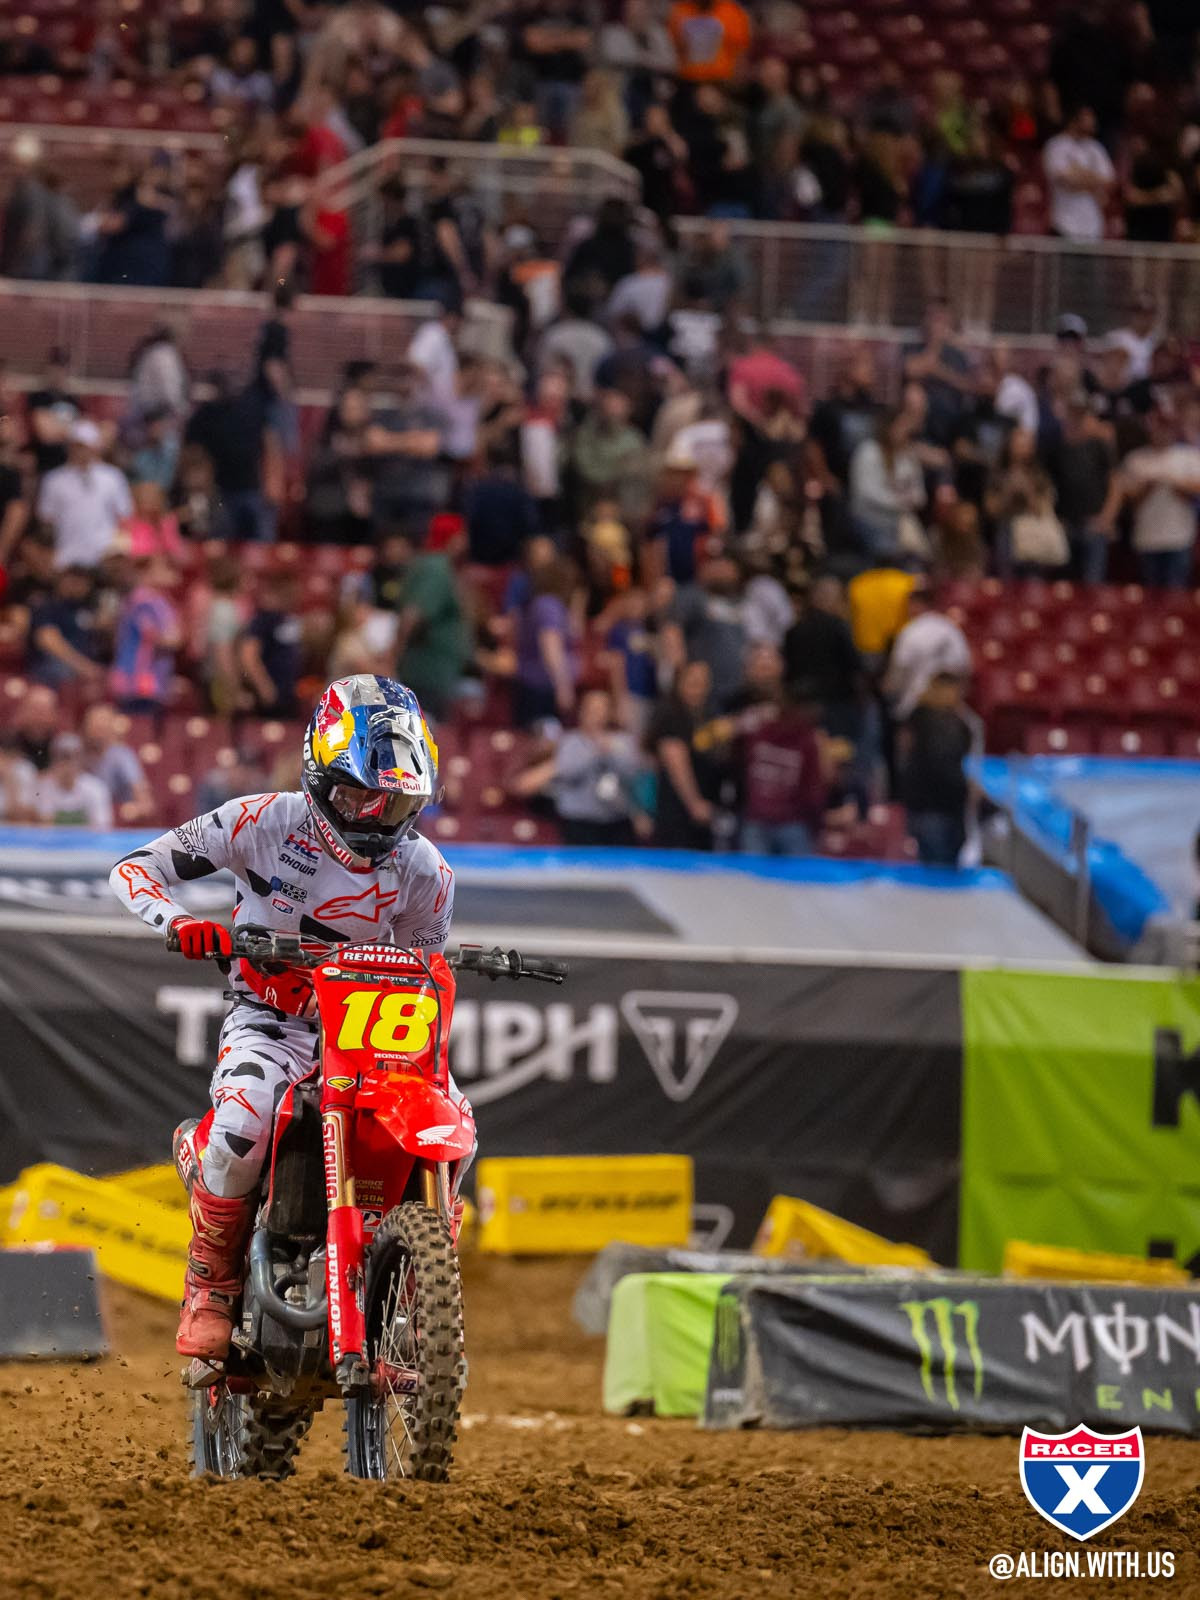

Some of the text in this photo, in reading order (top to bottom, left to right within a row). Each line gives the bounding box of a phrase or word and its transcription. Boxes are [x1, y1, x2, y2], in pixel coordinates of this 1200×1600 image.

[379, 778, 422, 791] Red Bull
[278, 853, 318, 877] SHOWA
[411, 933, 449, 947] HOND
[343, 952, 419, 965] RENTHAL
[337, 991, 439, 1053] 18
[374, 1053, 409, 1061] HONDA
[417, 1140, 463, 1149] HONDA
[327, 1243, 341, 1337] DUNLOP
